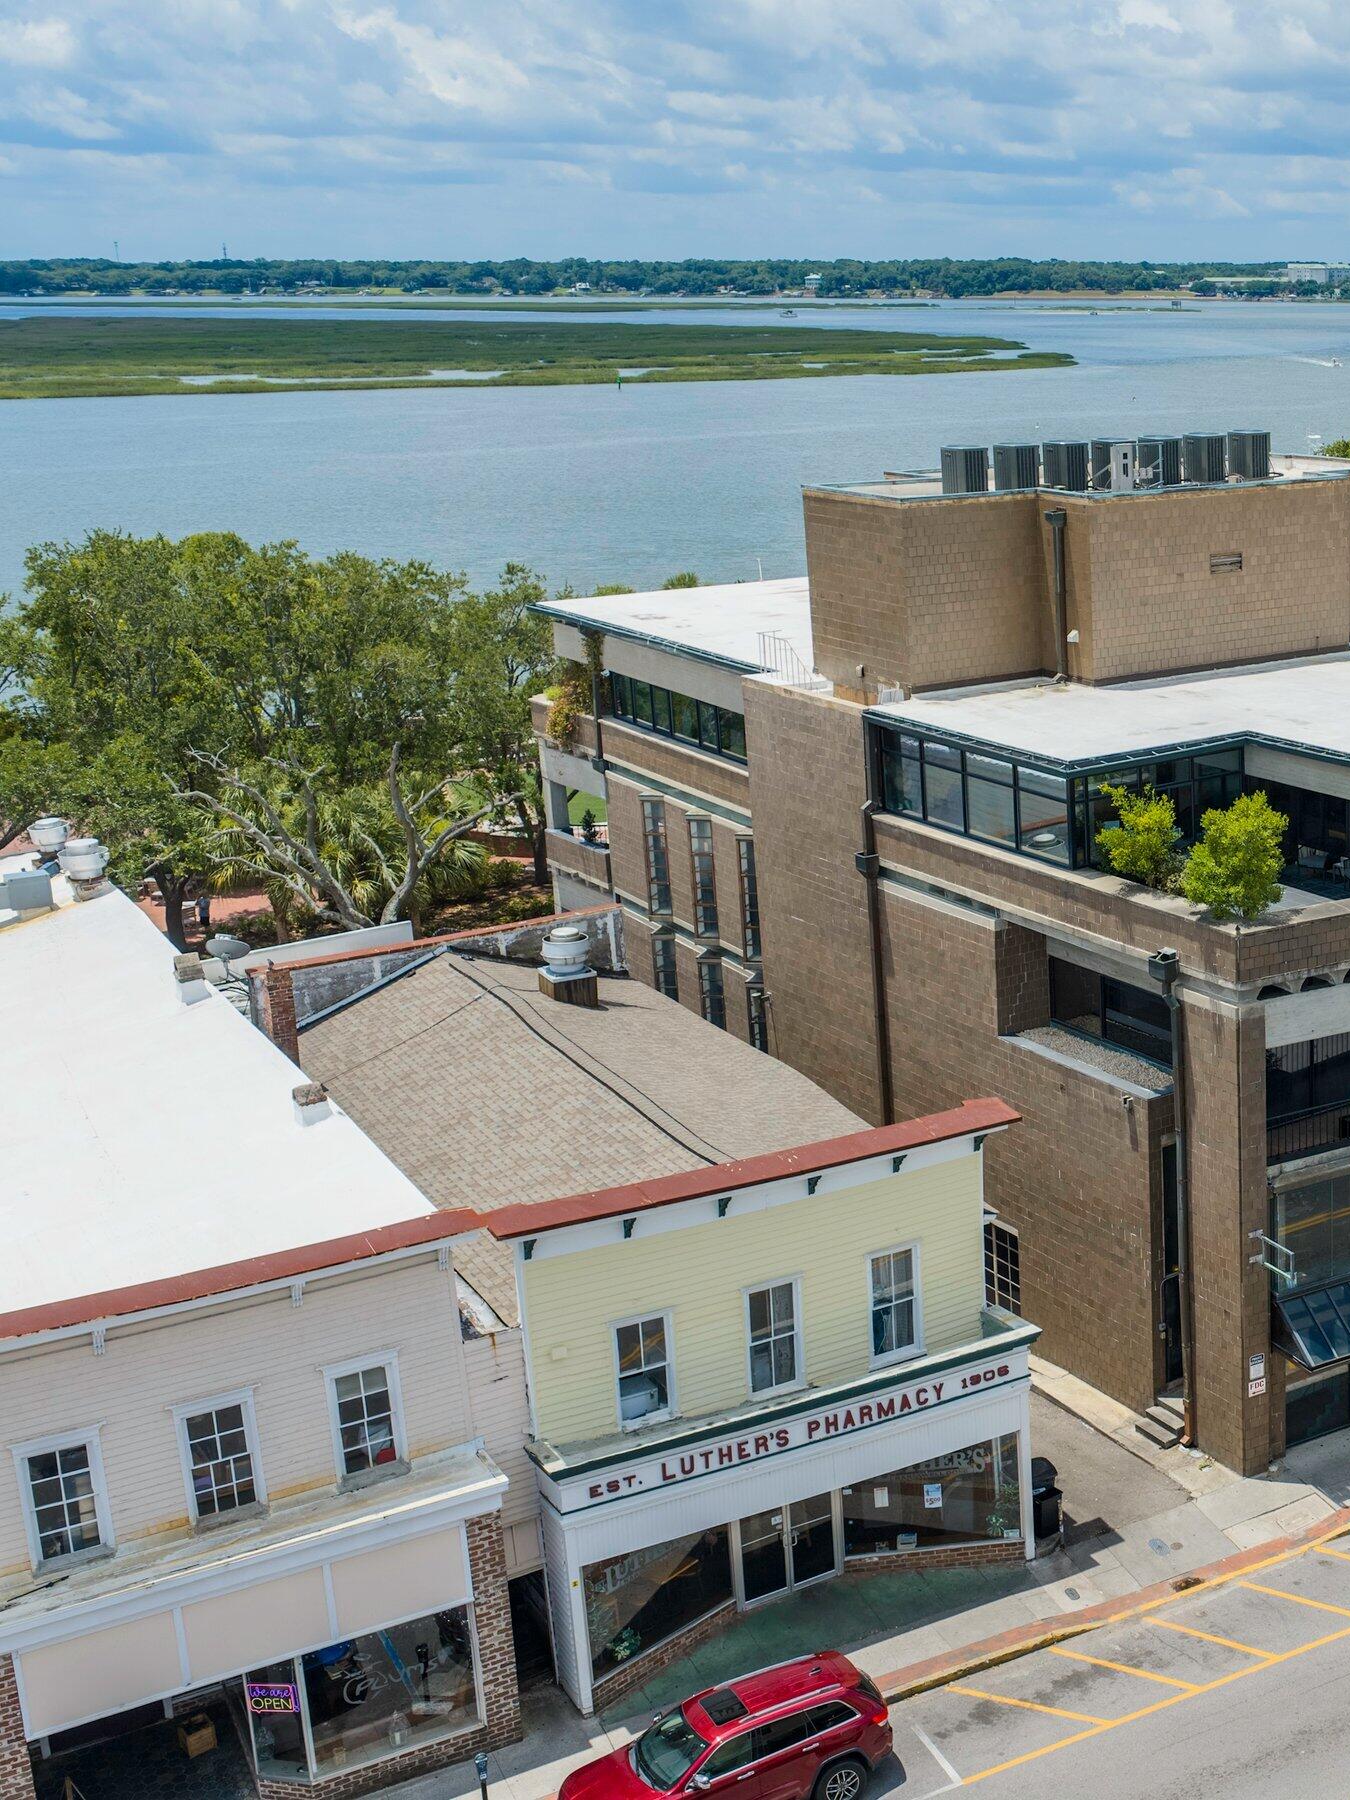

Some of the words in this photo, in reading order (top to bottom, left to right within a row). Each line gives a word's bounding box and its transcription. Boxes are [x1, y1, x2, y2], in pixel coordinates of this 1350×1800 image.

[1250, 1380, 1265, 1390] FDC
[588, 1474, 643, 1499] EST.
[661, 1429, 790, 1482] LUTHER'S
[807, 1382, 944, 1440] PHARMACY
[961, 1365, 1010, 1389] 1906
[269, 1688, 291, 1699] are
[251, 1697, 292, 1710] OPEN
